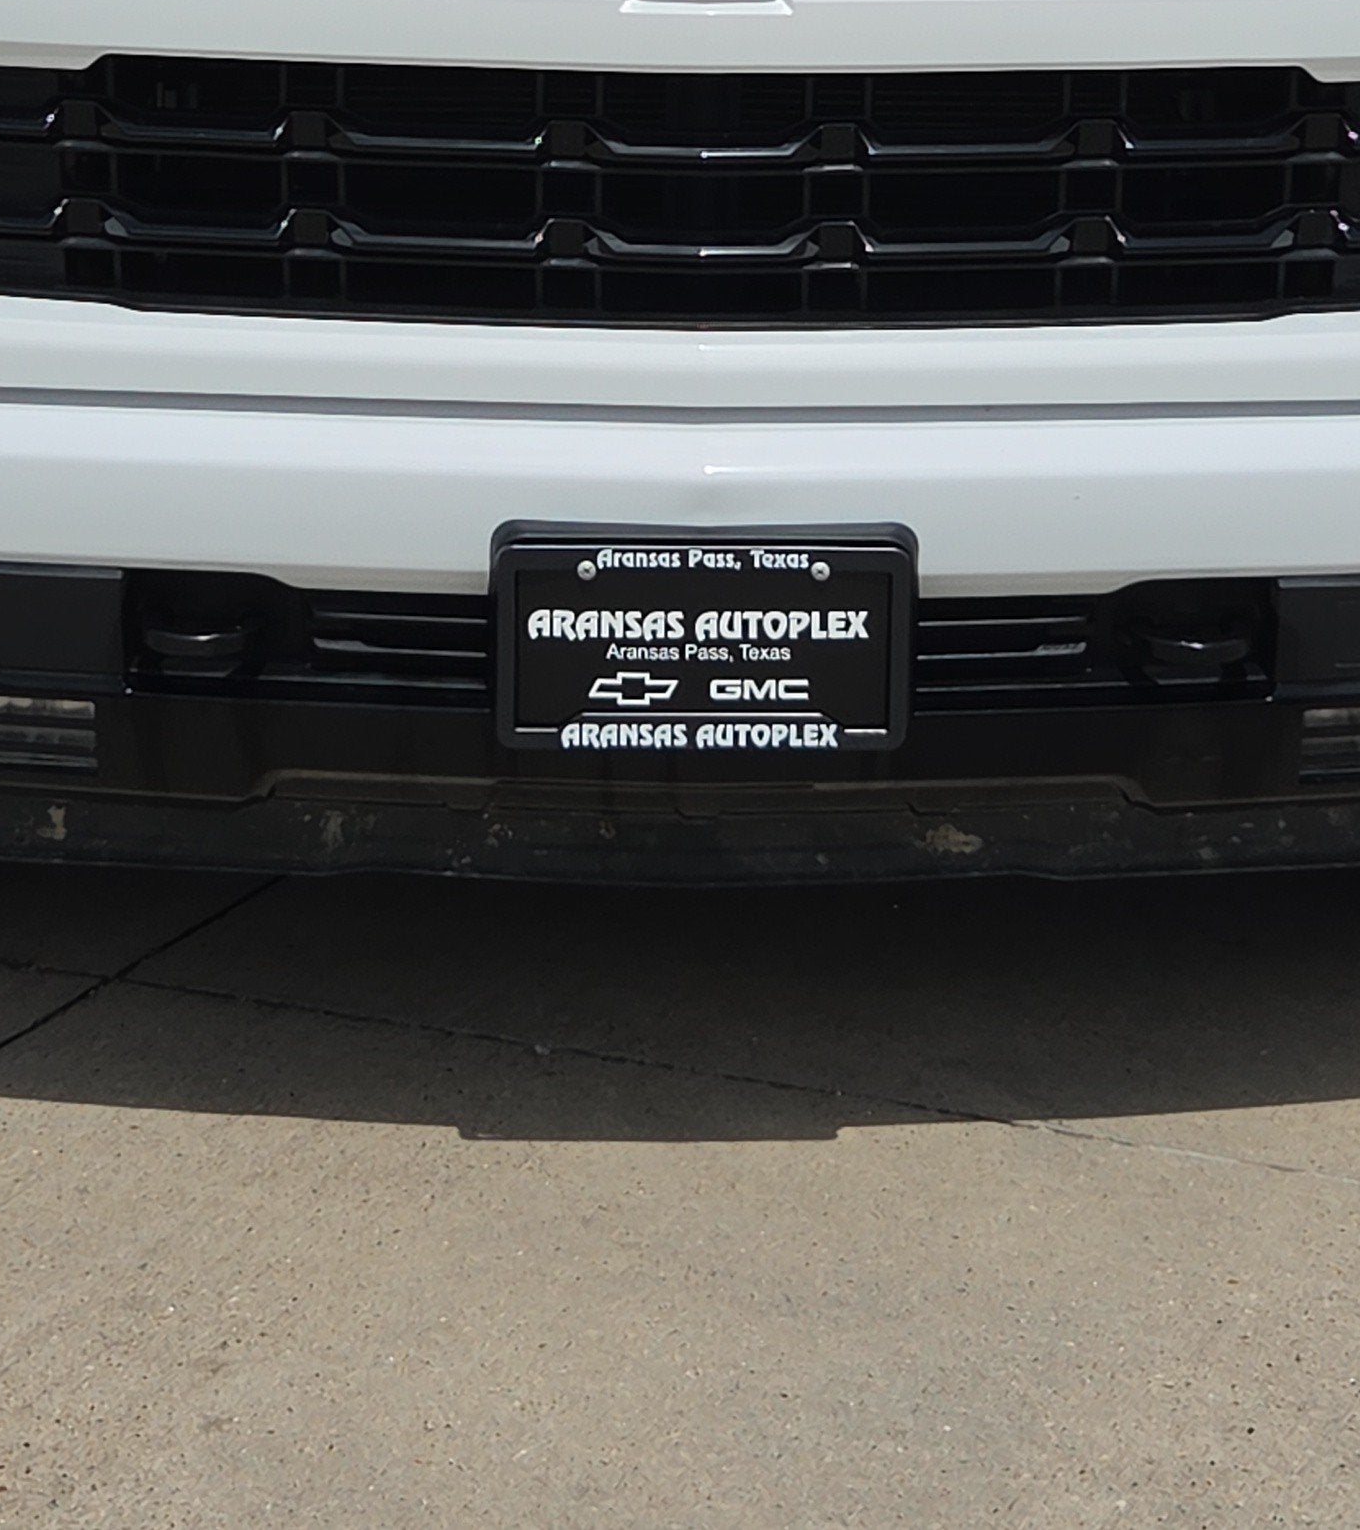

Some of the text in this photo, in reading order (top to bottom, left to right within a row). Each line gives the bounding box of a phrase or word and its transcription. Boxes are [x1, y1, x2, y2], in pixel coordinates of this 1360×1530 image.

[596, 548, 810, 571] Aransas Pass, Texas
[527, 609, 869, 642] ARANSAS AUTOPLEX
[605, 643, 791, 662] Aransas Pass, Texas
[709, 678, 809, 701] GMC
[560, 723, 839, 749] ARANSAS AUTOPLEX
